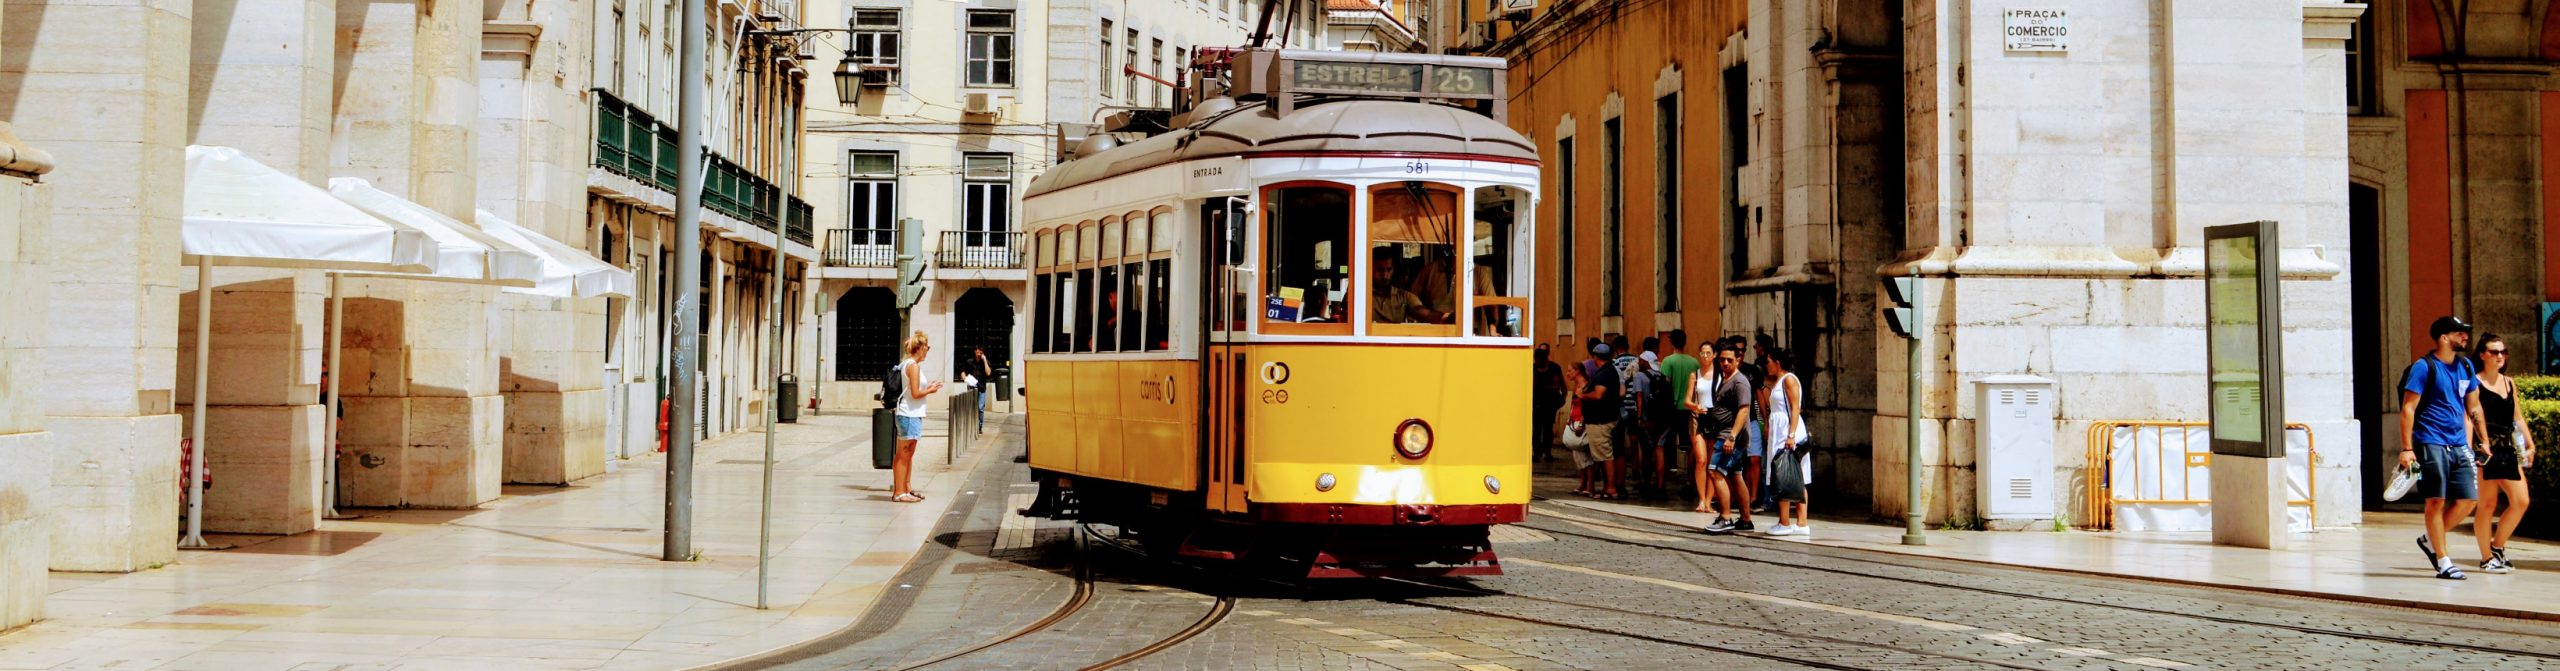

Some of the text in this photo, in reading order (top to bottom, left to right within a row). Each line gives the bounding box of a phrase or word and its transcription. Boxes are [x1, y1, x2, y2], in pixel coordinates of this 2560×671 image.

[2016, 10, 2058, 21] PRAÇA
[2007, 26, 2067, 36] COMERCIO
[1301, 64, 1411, 85] ESTRELA
[1437, 68, 1474, 92] 25
[1193, 166, 1222, 178] ENTRADA
[1406, 162, 1429, 174] 581
[1270, 298, 1283, 306] 25E
[1267, 308, 1280, 319] 01
